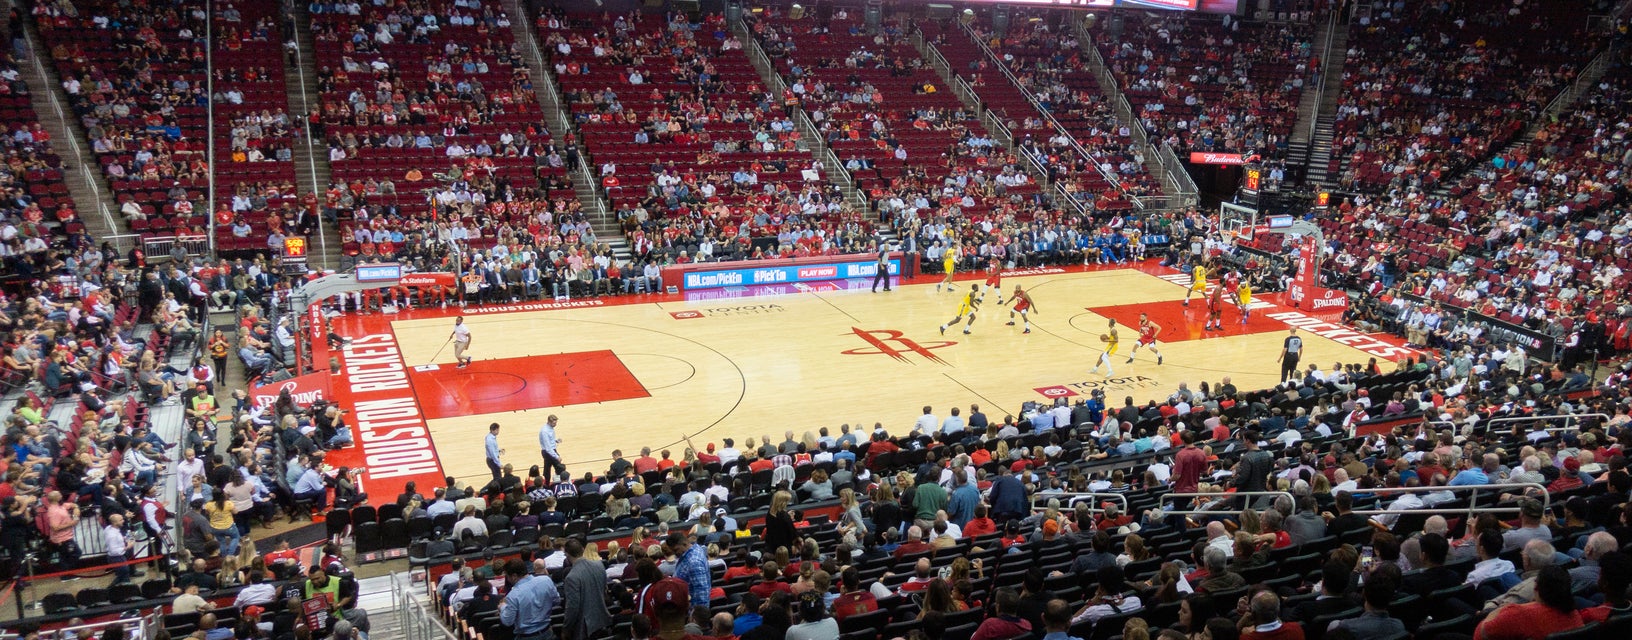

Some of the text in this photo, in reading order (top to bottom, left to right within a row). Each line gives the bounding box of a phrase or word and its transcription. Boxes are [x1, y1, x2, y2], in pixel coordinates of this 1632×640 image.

[1249, 179, 1257, 189] 14
[290, 247, 301, 255] 14
[688, 268, 834, 287] NBA.com/PickEm Pick'Em PLAY NOW
[704, 304, 782, 313] TOYOTA
[1313, 297, 1346, 309] SPALDING
[311, 304, 321, 338] NBA TV
[1265, 312, 1412, 357] ROCKETS
[342, 333, 410, 393] ROCKETS
[1068, 375, 1153, 388] TOYOTA
[1081, 381, 1164, 394] CNTER
[256, 389, 323, 409] SPDING
[354, 397, 439, 480] HOUSTON
